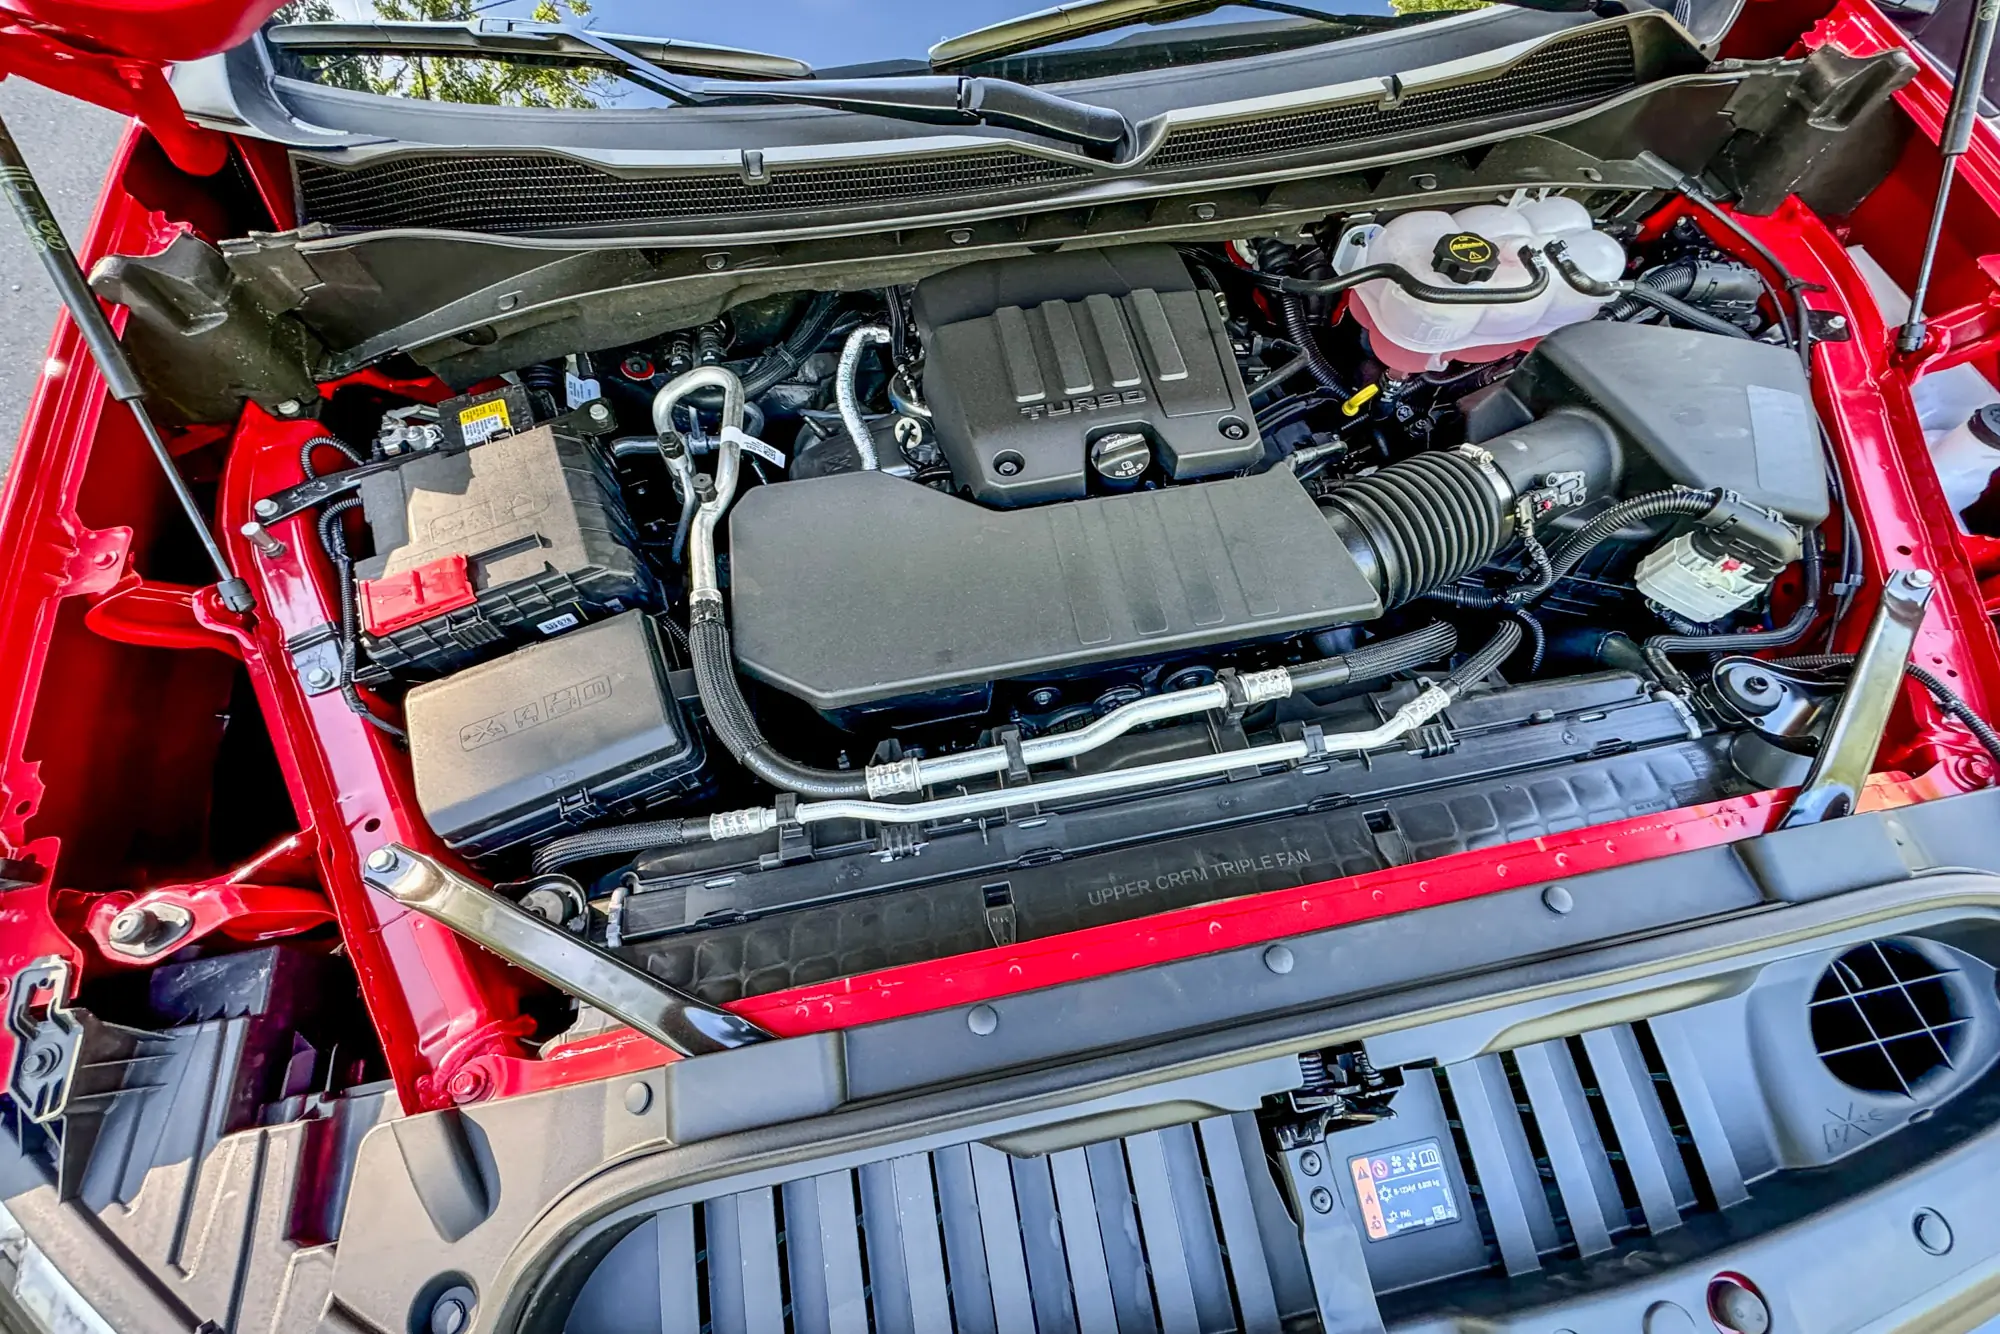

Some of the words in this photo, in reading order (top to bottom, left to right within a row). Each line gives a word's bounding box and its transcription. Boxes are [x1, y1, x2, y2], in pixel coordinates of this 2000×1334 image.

[1020, 389, 1147, 420] TURBO
[803, 784, 834, 793] SUCTION
[834, 784, 855, 793] HOSE
[1087, 879, 1153, 906] UPPER
[1155, 867, 1209, 890] CRFM
[1210, 855, 1275, 877] TRIPLE
[1275, 848, 1312, 867] FAN
